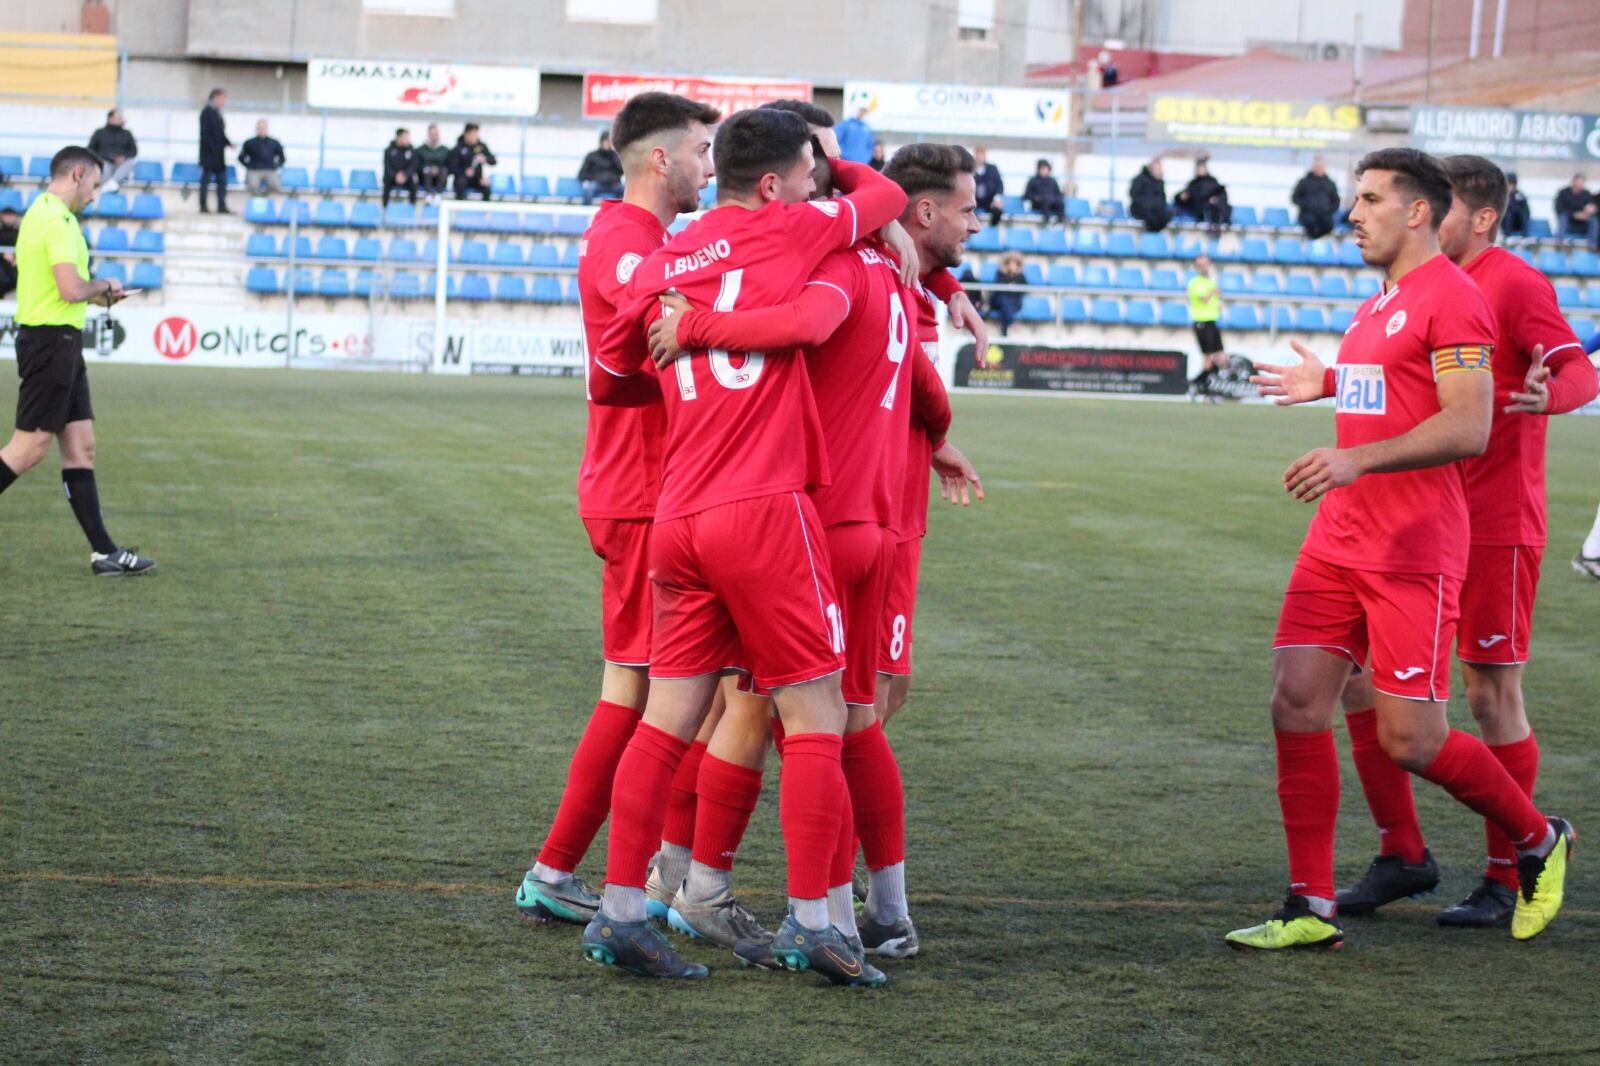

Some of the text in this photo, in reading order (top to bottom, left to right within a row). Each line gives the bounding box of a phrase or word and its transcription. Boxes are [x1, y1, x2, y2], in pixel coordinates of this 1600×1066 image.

[320, 64, 431, 80] JOMASAN
[915, 87, 996, 106] COINPA
[1153, 97, 1360, 129] SIDIGLAS
[1414, 109, 1584, 143] ALEJANDRO ABASO
[664, 239, 731, 280] I.BUENO
[480, 335, 543, 356] SALVA
[880, 291, 909, 410] 9
[890, 614, 906, 660] 8
